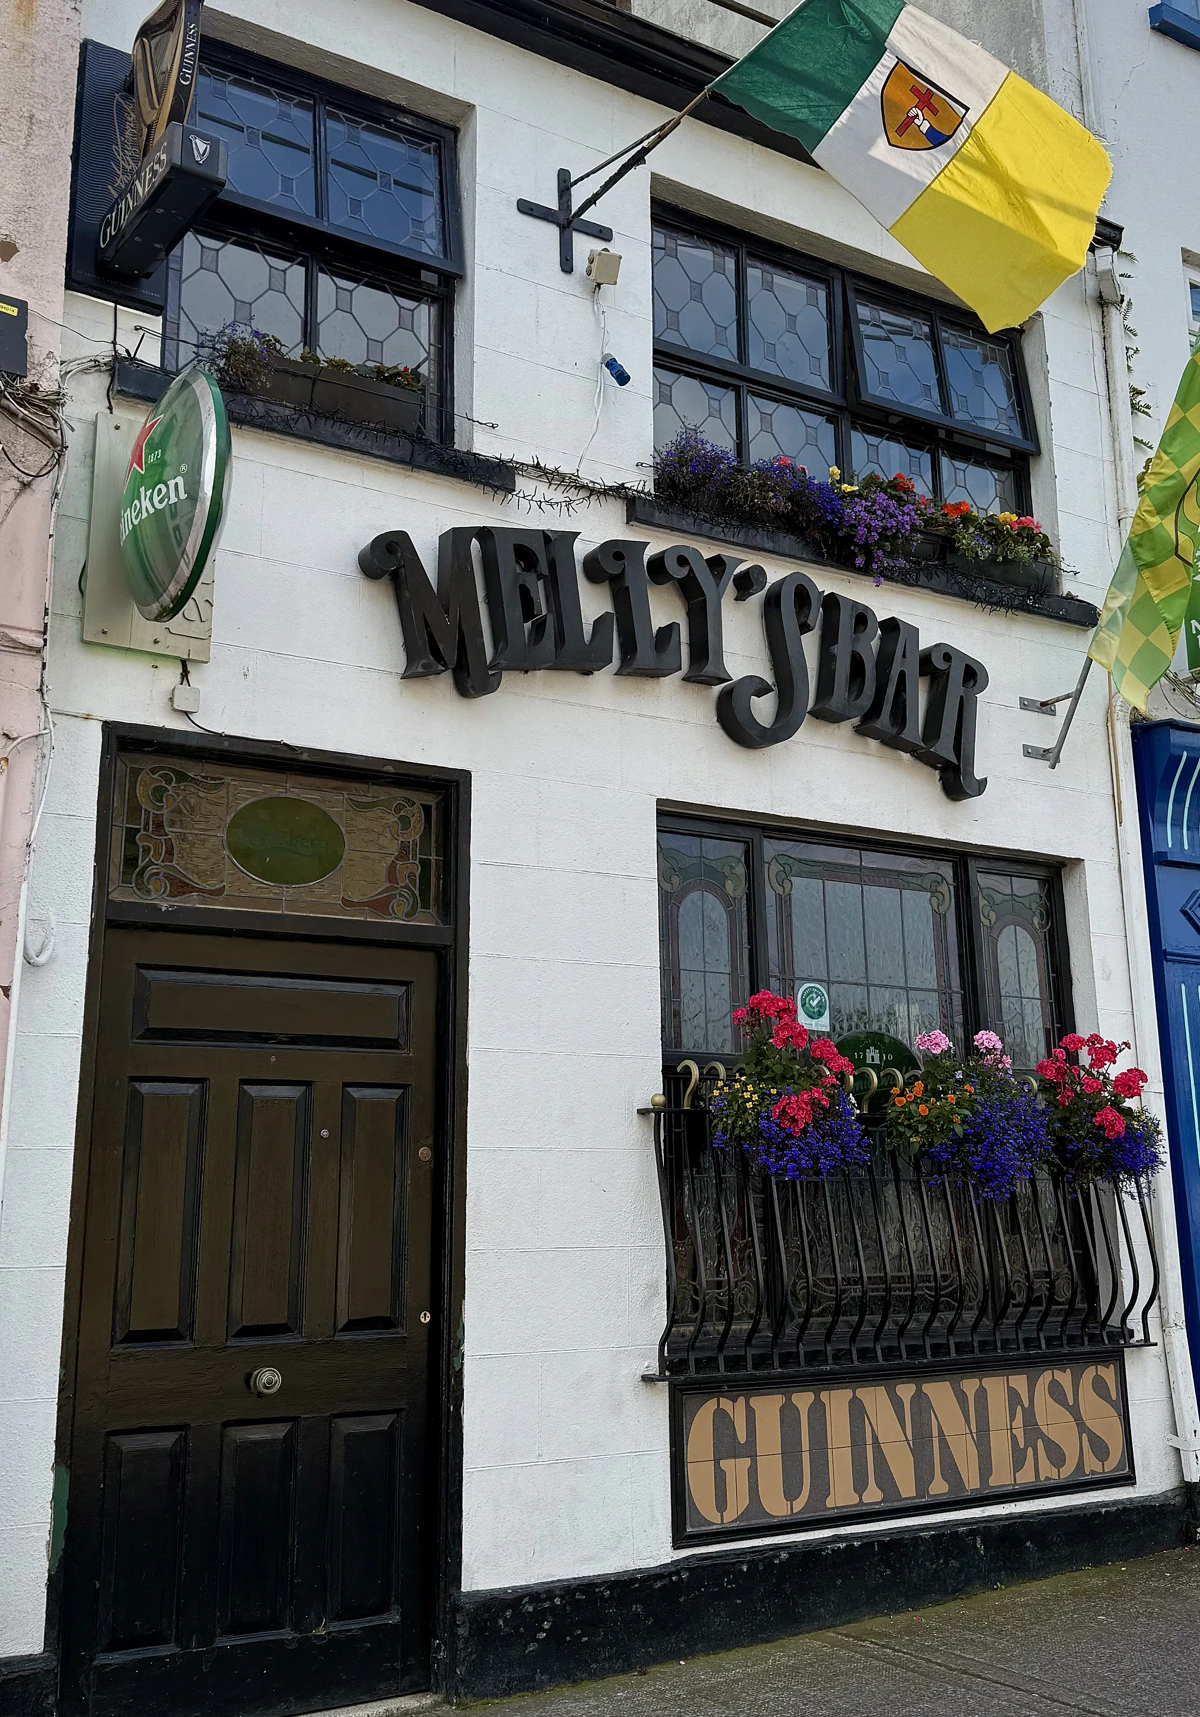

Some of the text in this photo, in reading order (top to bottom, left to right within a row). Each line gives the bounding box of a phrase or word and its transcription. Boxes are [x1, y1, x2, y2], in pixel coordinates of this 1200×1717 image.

[179, 22, 198, 86] GUINNESS
[100, 142, 168, 249] GUINNESS
[148, 449, 161, 464] 1873
[120, 475, 188, 547] ineken
[358, 525, 990, 801] MELLY'S BAR
[686, 1362, 1123, 1525] GUINNESS
